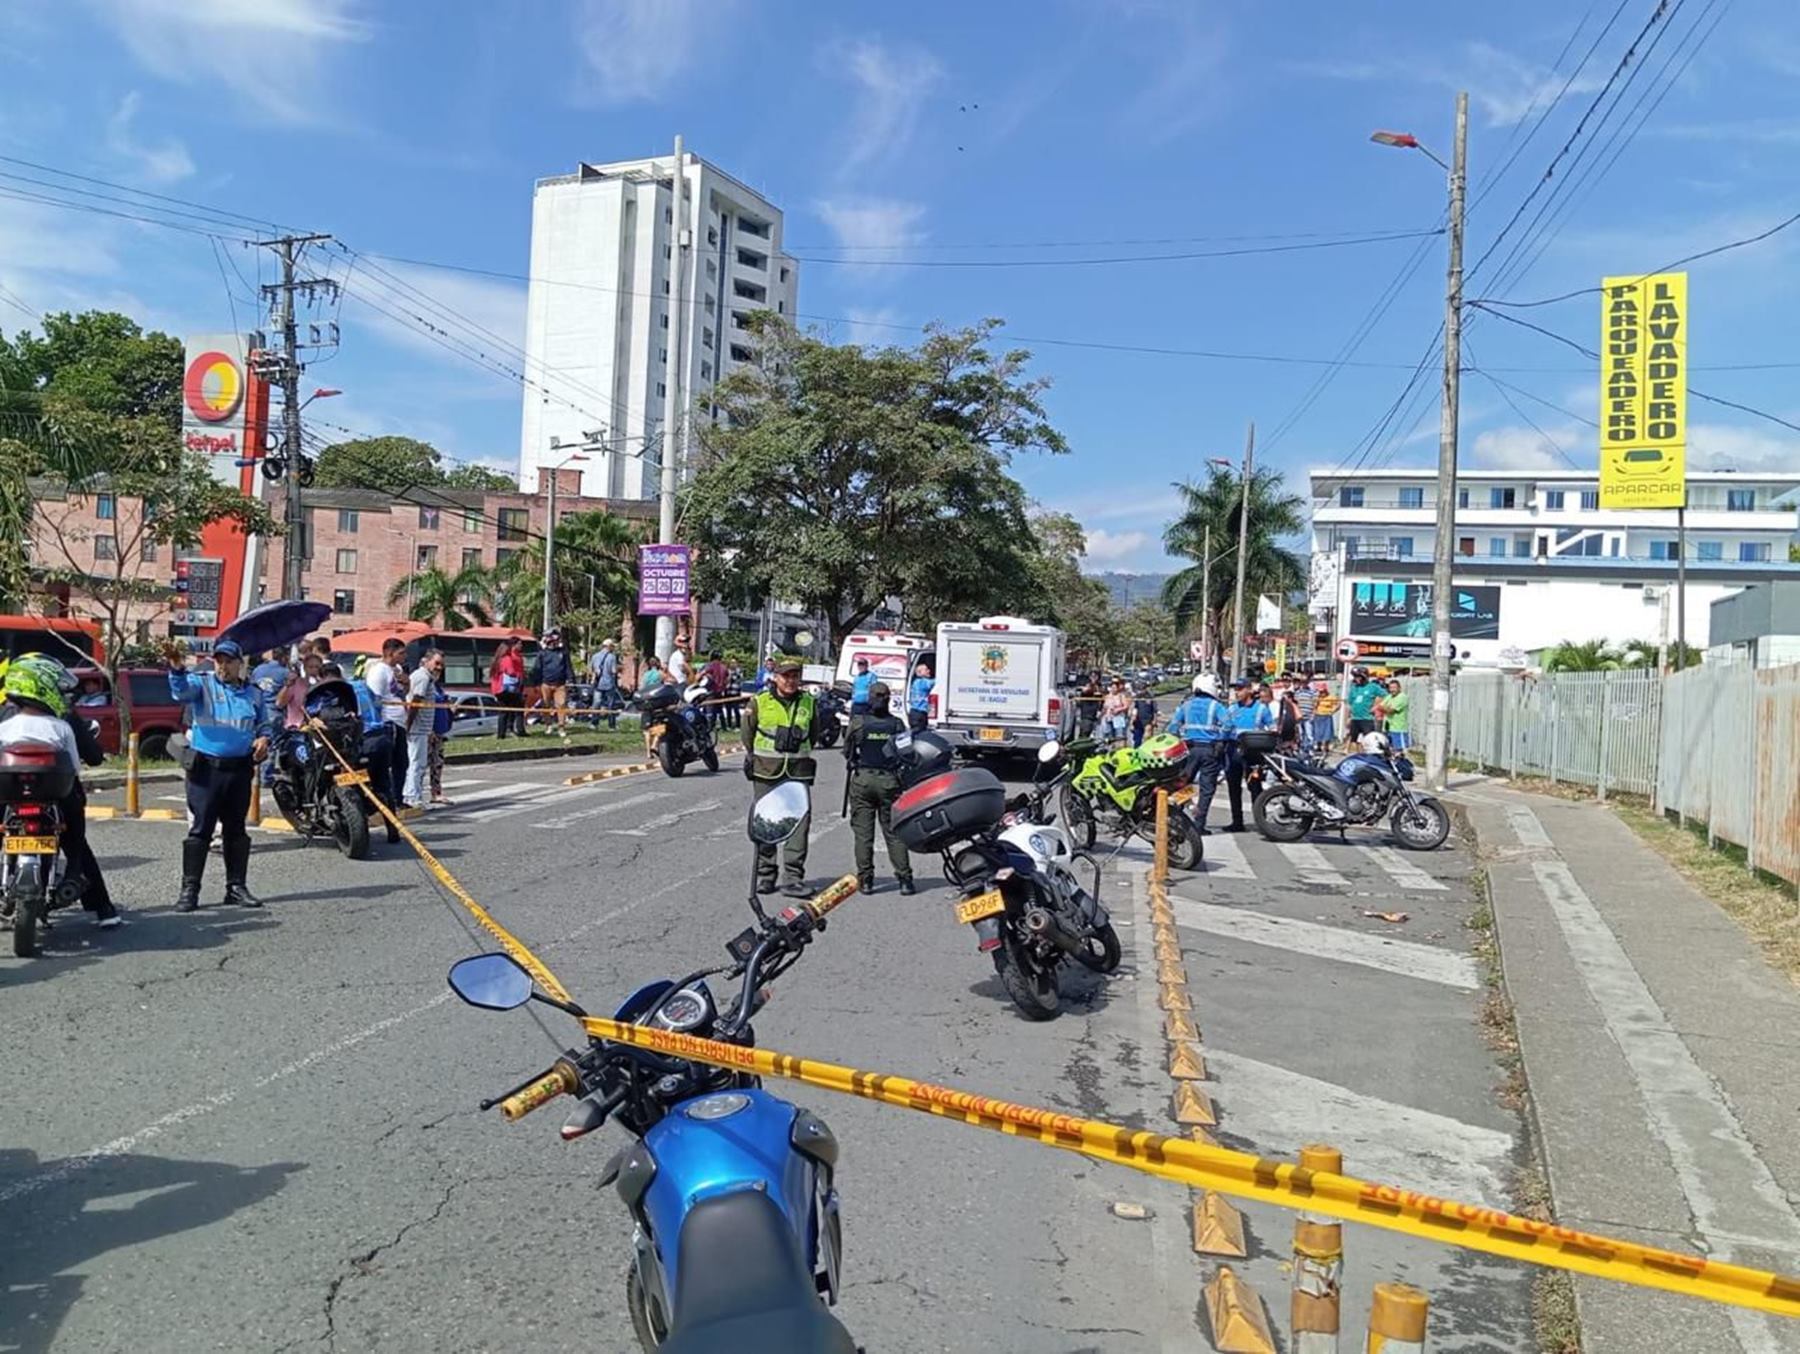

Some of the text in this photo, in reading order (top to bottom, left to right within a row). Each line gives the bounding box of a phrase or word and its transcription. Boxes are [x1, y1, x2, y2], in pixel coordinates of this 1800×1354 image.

[1607, 285, 1638, 442] PARQUEADERO
[1648, 283, 1680, 440] LAVADERO
[643, 568, 686, 577] OCTUBRE
[644, 581, 656, 592] 25
[673, 581, 684, 592] 27
